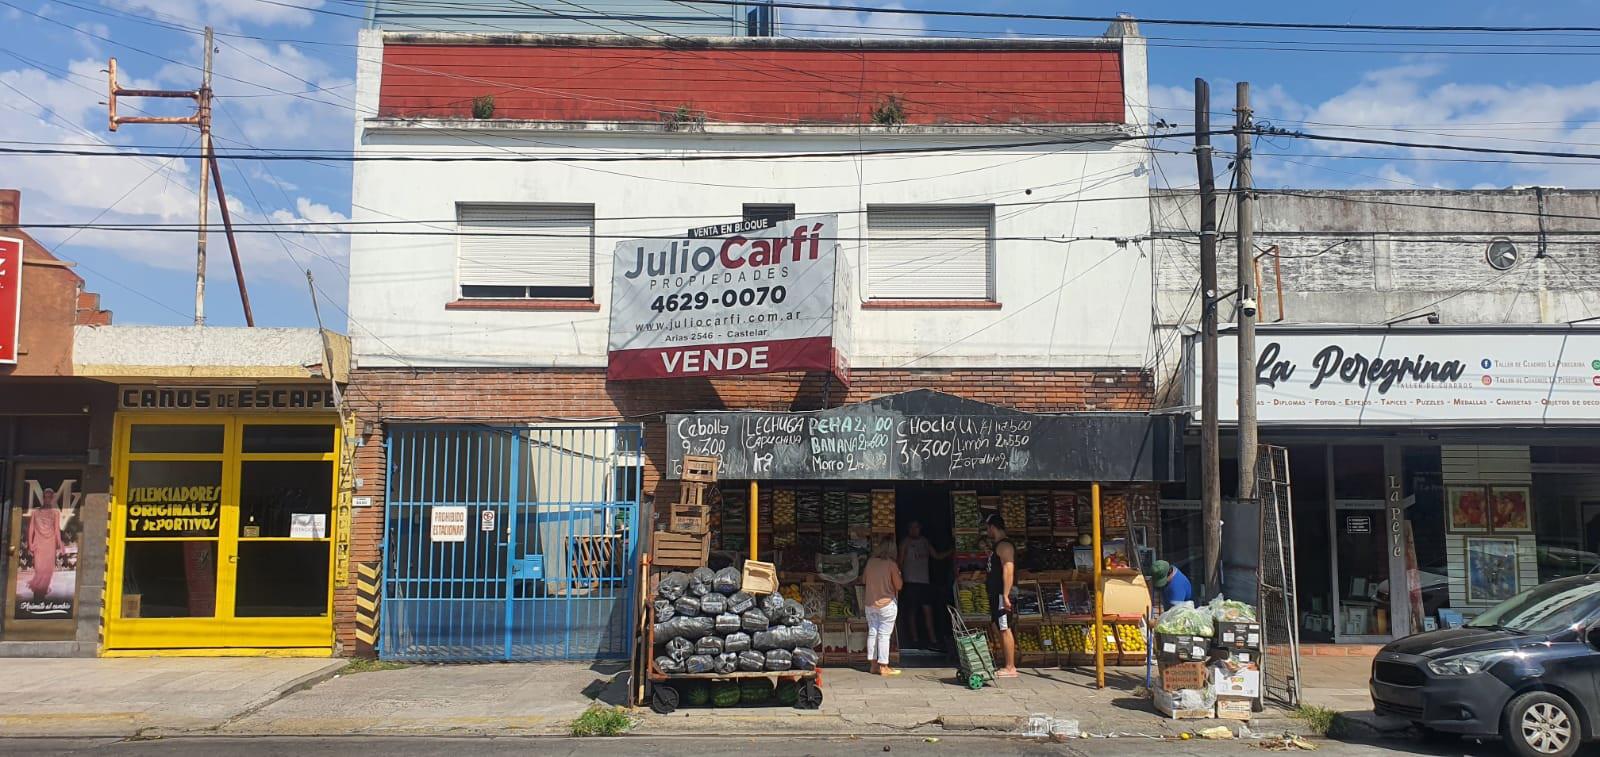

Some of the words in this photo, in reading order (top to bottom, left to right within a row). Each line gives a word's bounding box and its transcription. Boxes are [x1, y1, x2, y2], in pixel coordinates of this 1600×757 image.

[694, 227, 719, 238] VENTA
[721, 223, 732, 234] EN
[735, 218, 768, 233] BLOQUE
[624, 240, 715, 279] Julio
[720, 222, 825, 269] Carfí
[650, 266, 790, 290] PROPIEDADES
[650, 285, 787, 313] 4629-0070
[635, 310, 801, 332] www.juliocarfi.com.ar
[665, 334, 688, 342] Arias
[691, 332, 713, 341] 2546
[727, 328, 768, 339] Castelar
[661, 346, 769, 373] VENDE
[1256, 342, 1296, 389] La
[1309, 344, 1466, 394] Peregrina
[217, 393, 235, 408] DE
[238, 389, 336, 408] ESCAPE
[678, 417, 729, 440] Cebolla
[746, 416, 805, 437] LECHUGA
[811, 436, 858, 455] BANANA
[128, 486, 222, 502] SILENCIADORES
[129, 503, 219, 517] ORIGINALES
[435, 512, 464, 522] PROHIBIDO
[129, 519, 139, 531] Y
[433, 525, 464, 535] ESTACIONAR
